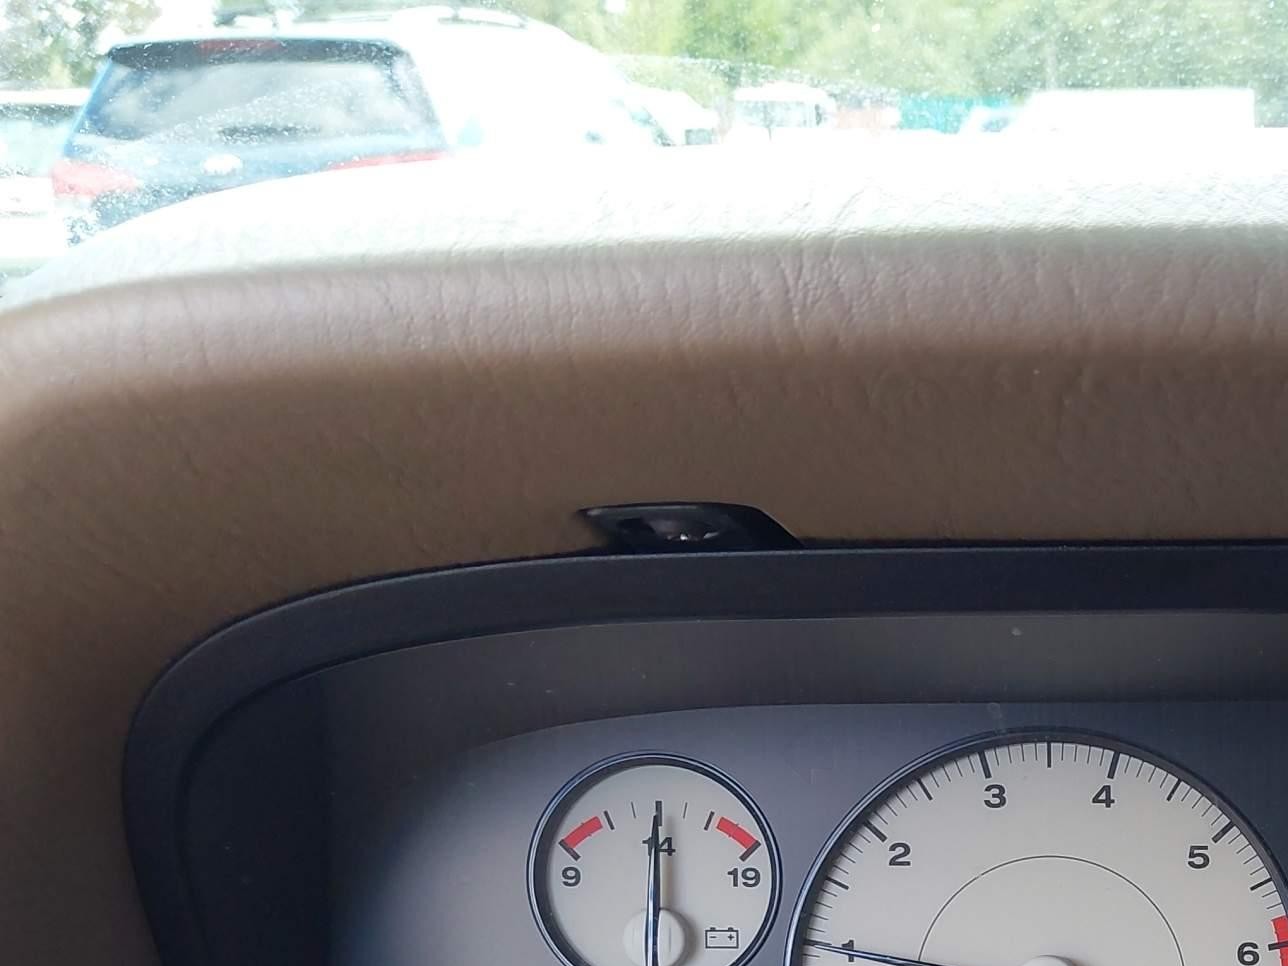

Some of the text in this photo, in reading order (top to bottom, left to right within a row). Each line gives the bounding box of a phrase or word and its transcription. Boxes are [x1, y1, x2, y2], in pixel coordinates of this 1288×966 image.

[983, 783, 1007, 809] 3
[1091, 784, 1115, 809] 4
[888, 842, 911, 867] 2
[1187, 845, 1210, 870] 5
[561, 866, 581, 887] 9
[727, 867, 761, 888] 19
[1237, 941, 1260, 966] 6
